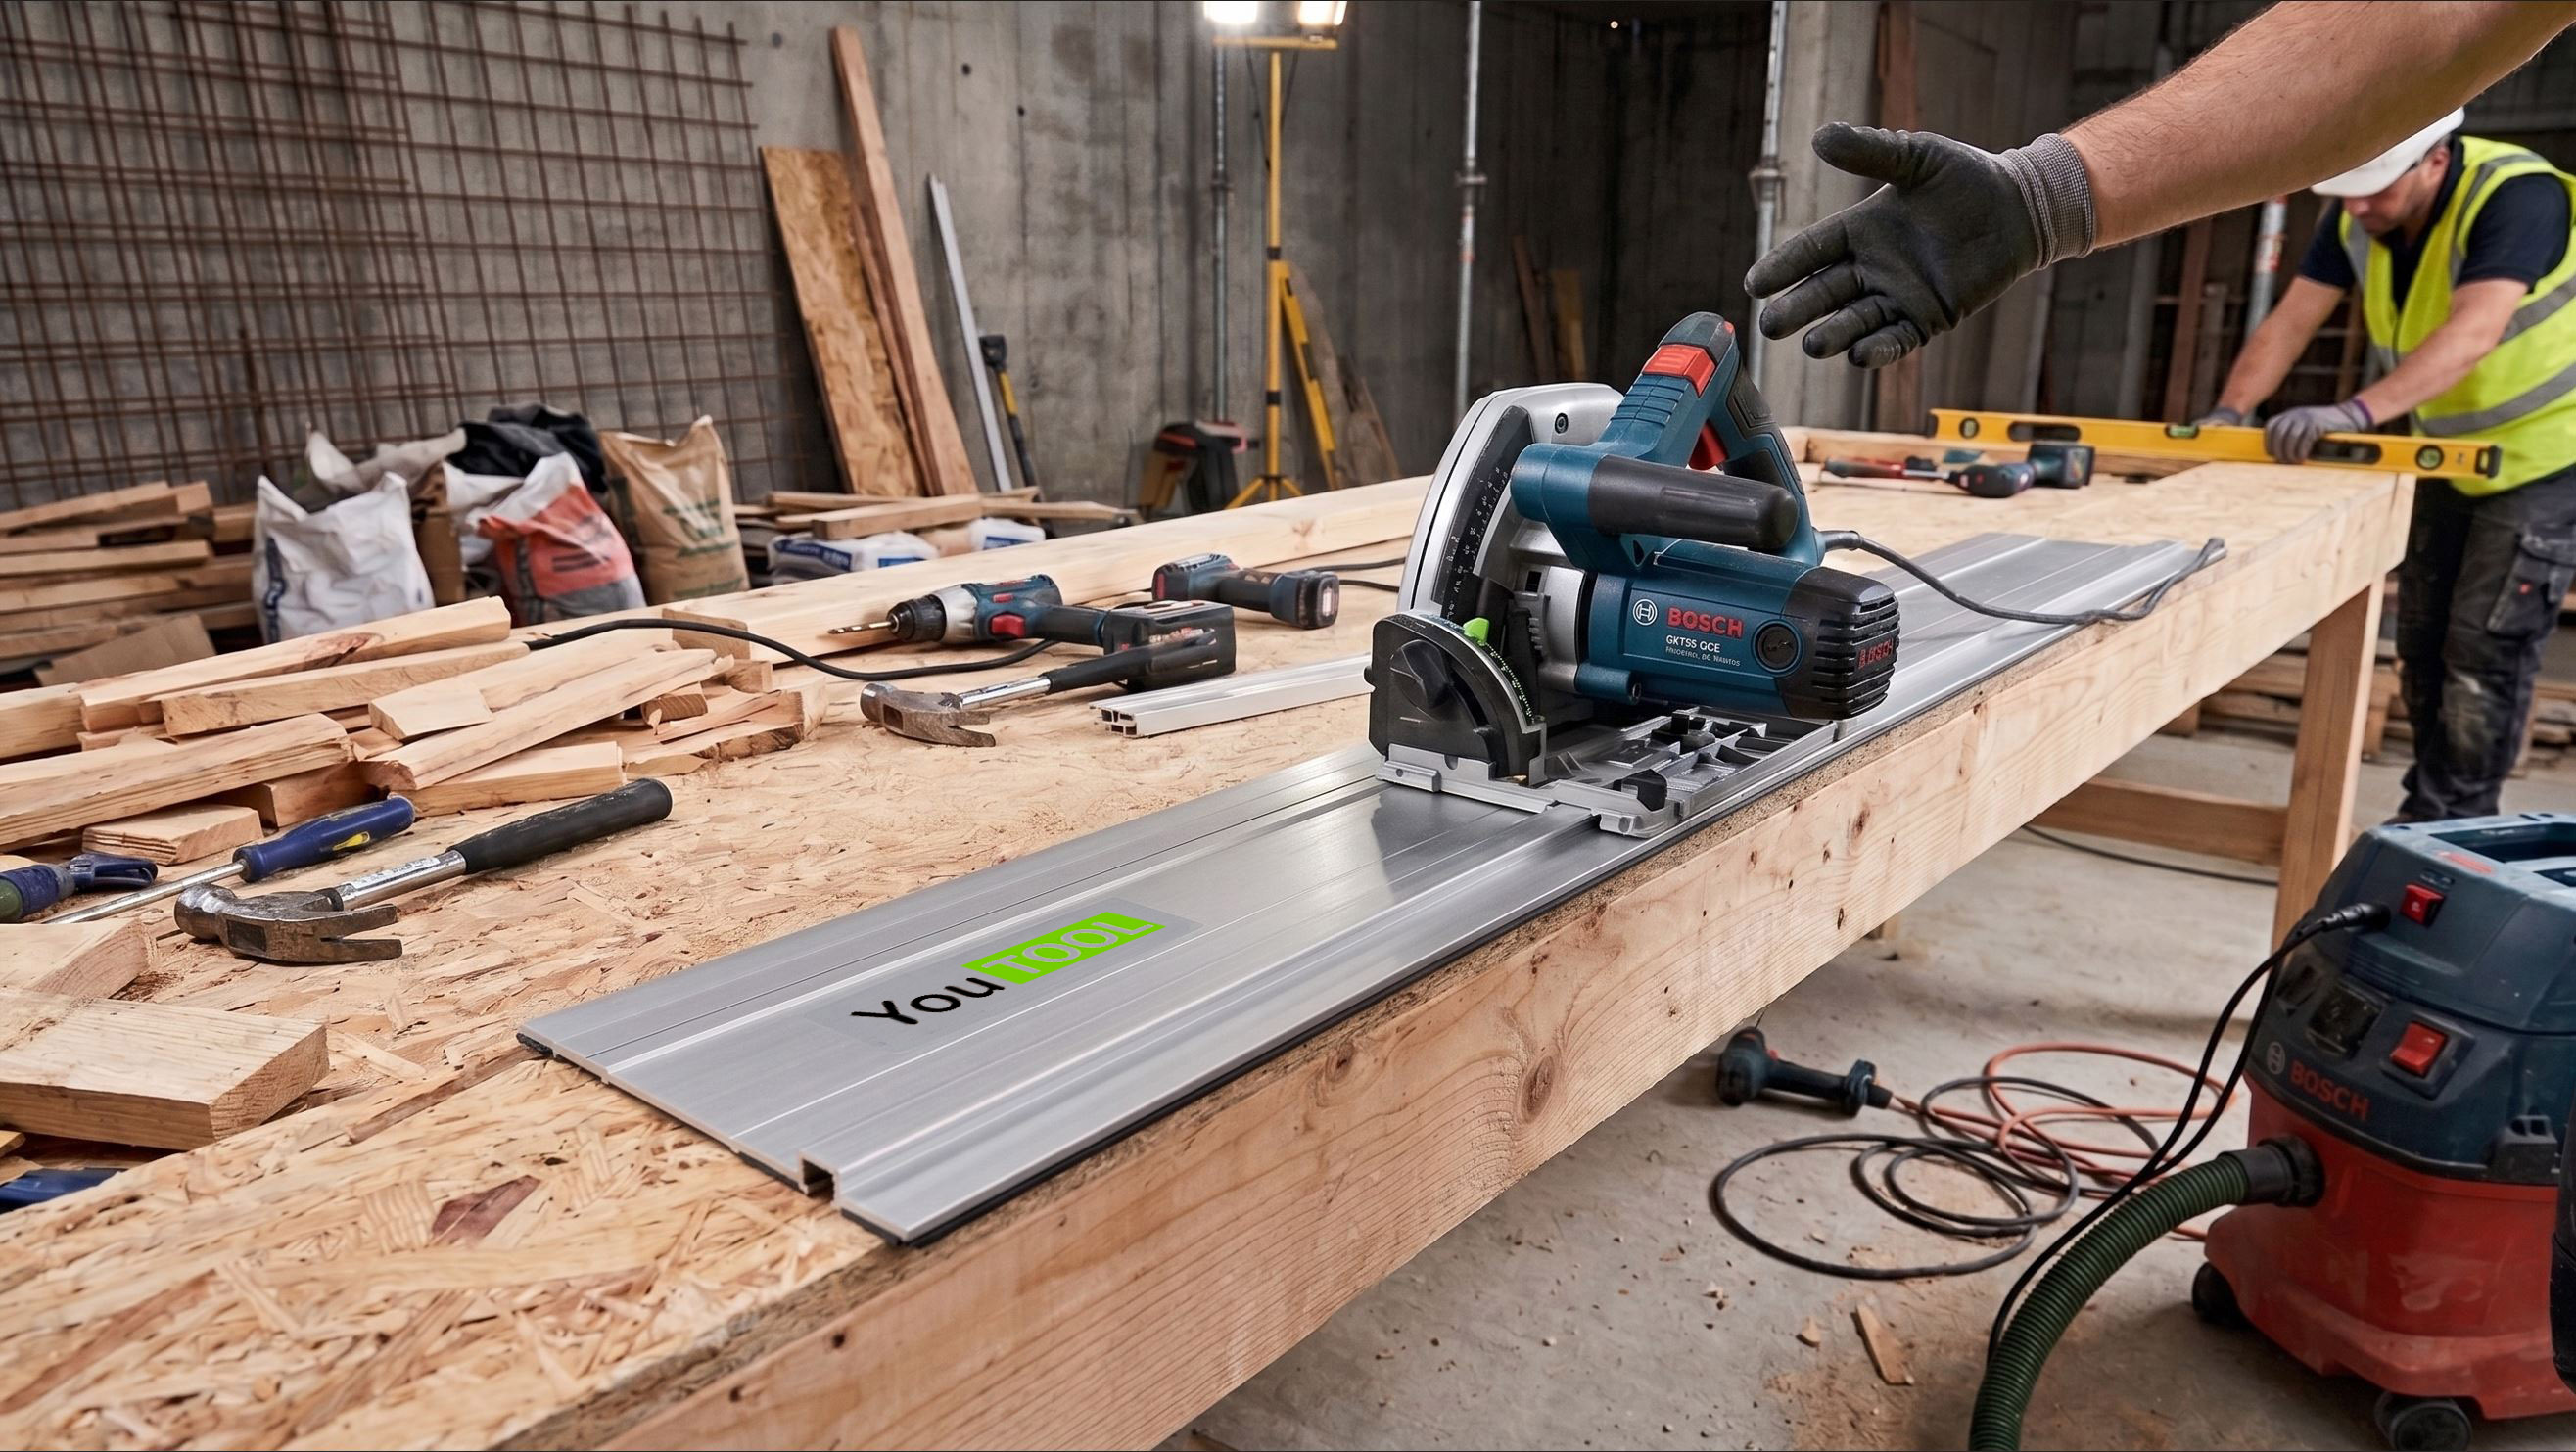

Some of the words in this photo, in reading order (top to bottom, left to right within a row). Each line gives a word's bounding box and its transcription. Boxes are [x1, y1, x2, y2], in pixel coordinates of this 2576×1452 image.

[1667, 607, 1743, 638] BOSCH
[850, 977, 1006, 1025] You
[980, 921, 1155, 975] TOOL
[2291, 1059, 2370, 1122] BOSCH
